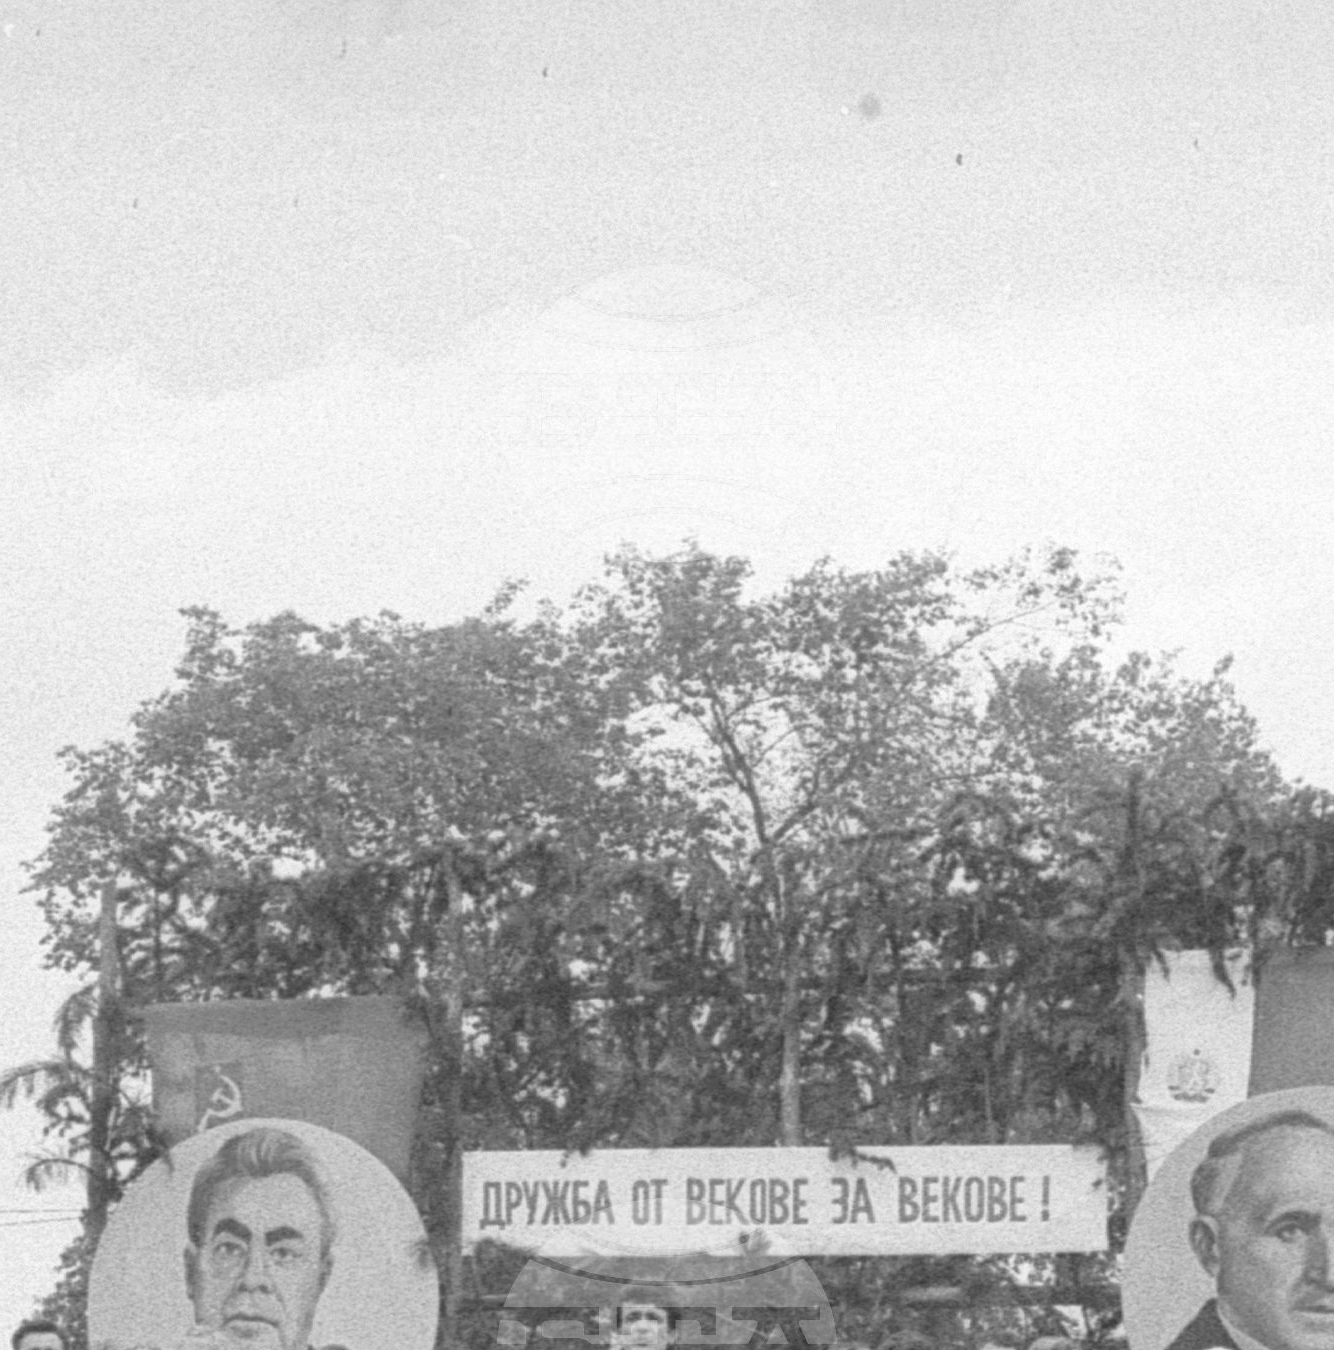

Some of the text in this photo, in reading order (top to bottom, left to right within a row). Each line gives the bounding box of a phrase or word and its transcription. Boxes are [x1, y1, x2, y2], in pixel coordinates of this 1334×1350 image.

[479, 1178, 616, 1231] ДРУЖБА
[631, 1178, 668, 1226] ОТ
[685, 1177, 810, 1226] ВЕКОВЕ
[830, 1177, 876, 1225] ЗА
